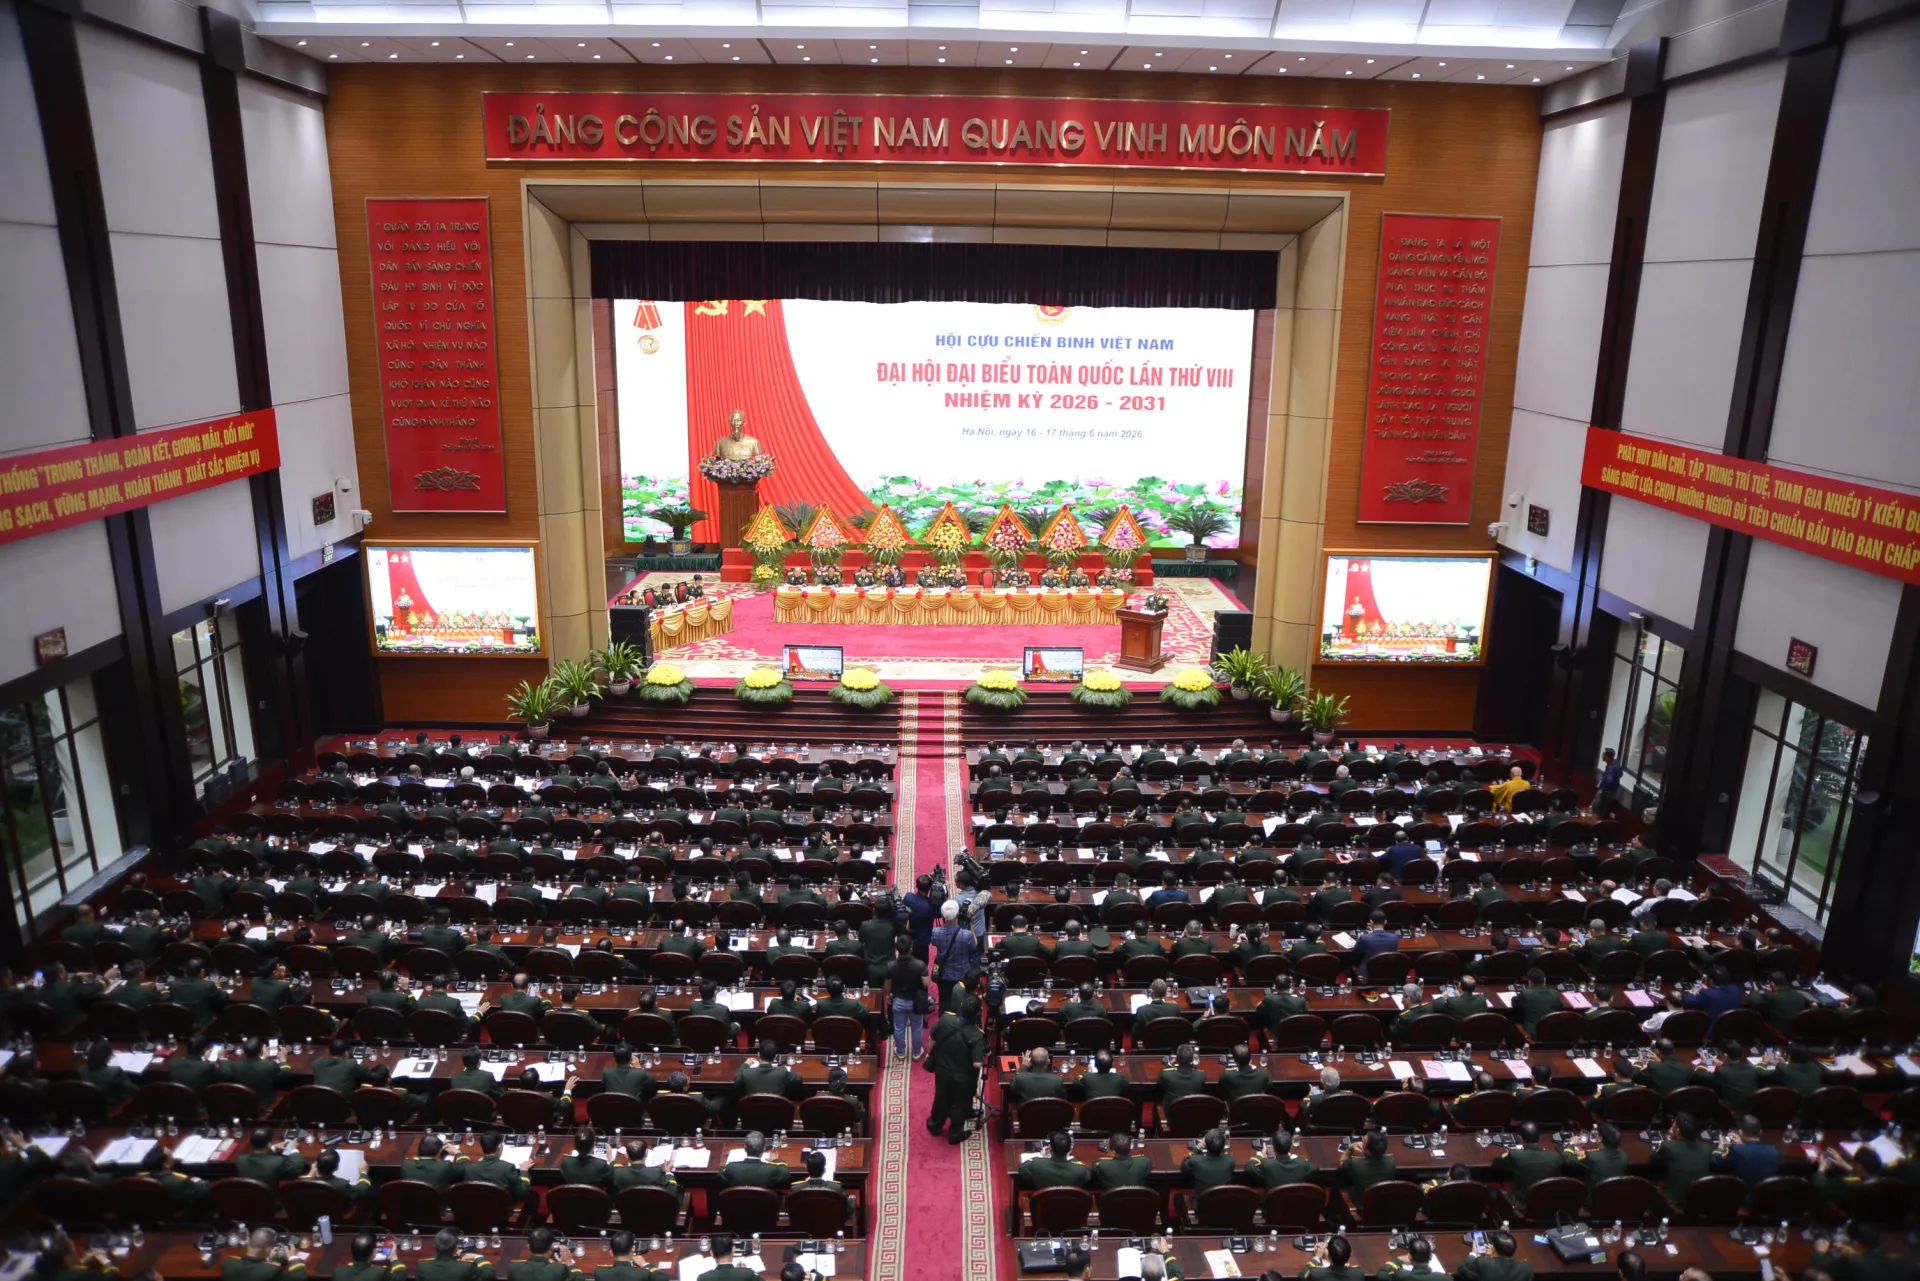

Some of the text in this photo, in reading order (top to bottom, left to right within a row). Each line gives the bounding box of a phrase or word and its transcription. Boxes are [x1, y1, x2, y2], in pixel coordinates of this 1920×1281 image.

[506, 102, 1358, 159] ĐẢNG CỘNG SẢN VIỆT NAM QUANG VINH MUÔN NĂM
[936, 333, 1174, 351] HỘI CỰU CHIẾN BINH VIỆT NAM
[877, 356, 1233, 387] ĐẠI HỘI ĐẠI BIỂU TOÀN QUỐC LẦN THỨ VIII
[945, 390, 1010, 411] NHIỆM
[1018, 391, 1043, 408] KỲ
[1050, 395, 1098, 409] 2026
[1120, 396, 1165, 410] 2031
[1121, 430, 1142, 438] 2026
[124, 474, 151, 500] HOÀN
[152, 467, 182, 492] THÀNH
[1617, 442, 1636, 462] PHÁT
[1636, 447, 1651, 465] HUY
[1651, 449, 1667, 471] DÂN
[1689, 457, 1704, 481] TẬP
[1705, 463, 1733, 487] TRUNG
[1736, 469, 1752, 491] TRÍ
[1773, 480, 1803, 504] THAM
[1804, 487, 1823, 510] GIA
[1824, 490, 1861, 518] NHIỀU
[1863, 496, 1872, 520] Ý
[1872, 499, 1905, 529] KIẾN
[1601, 464, 1620, 485] SÁNG
[1620, 468, 1639, 490] SUỐT
[1639, 476, 1653, 496] LỰA
[1654, 480, 1676, 503] CHỌN
[1676, 486, 1705, 511] NHỮNG
[1705, 493, 1733, 517] NGƯỜI
[1733, 498, 1748, 521] ĐỦ
[1748, 504, 1770, 528] TIÊU
[1770, 510, 1806, 539] CHUẨN
[1830, 526, 1854, 553] VÀO
[1855, 533, 1884, 561] BAN
[1884, 541, 1920, 570] CHẤP
